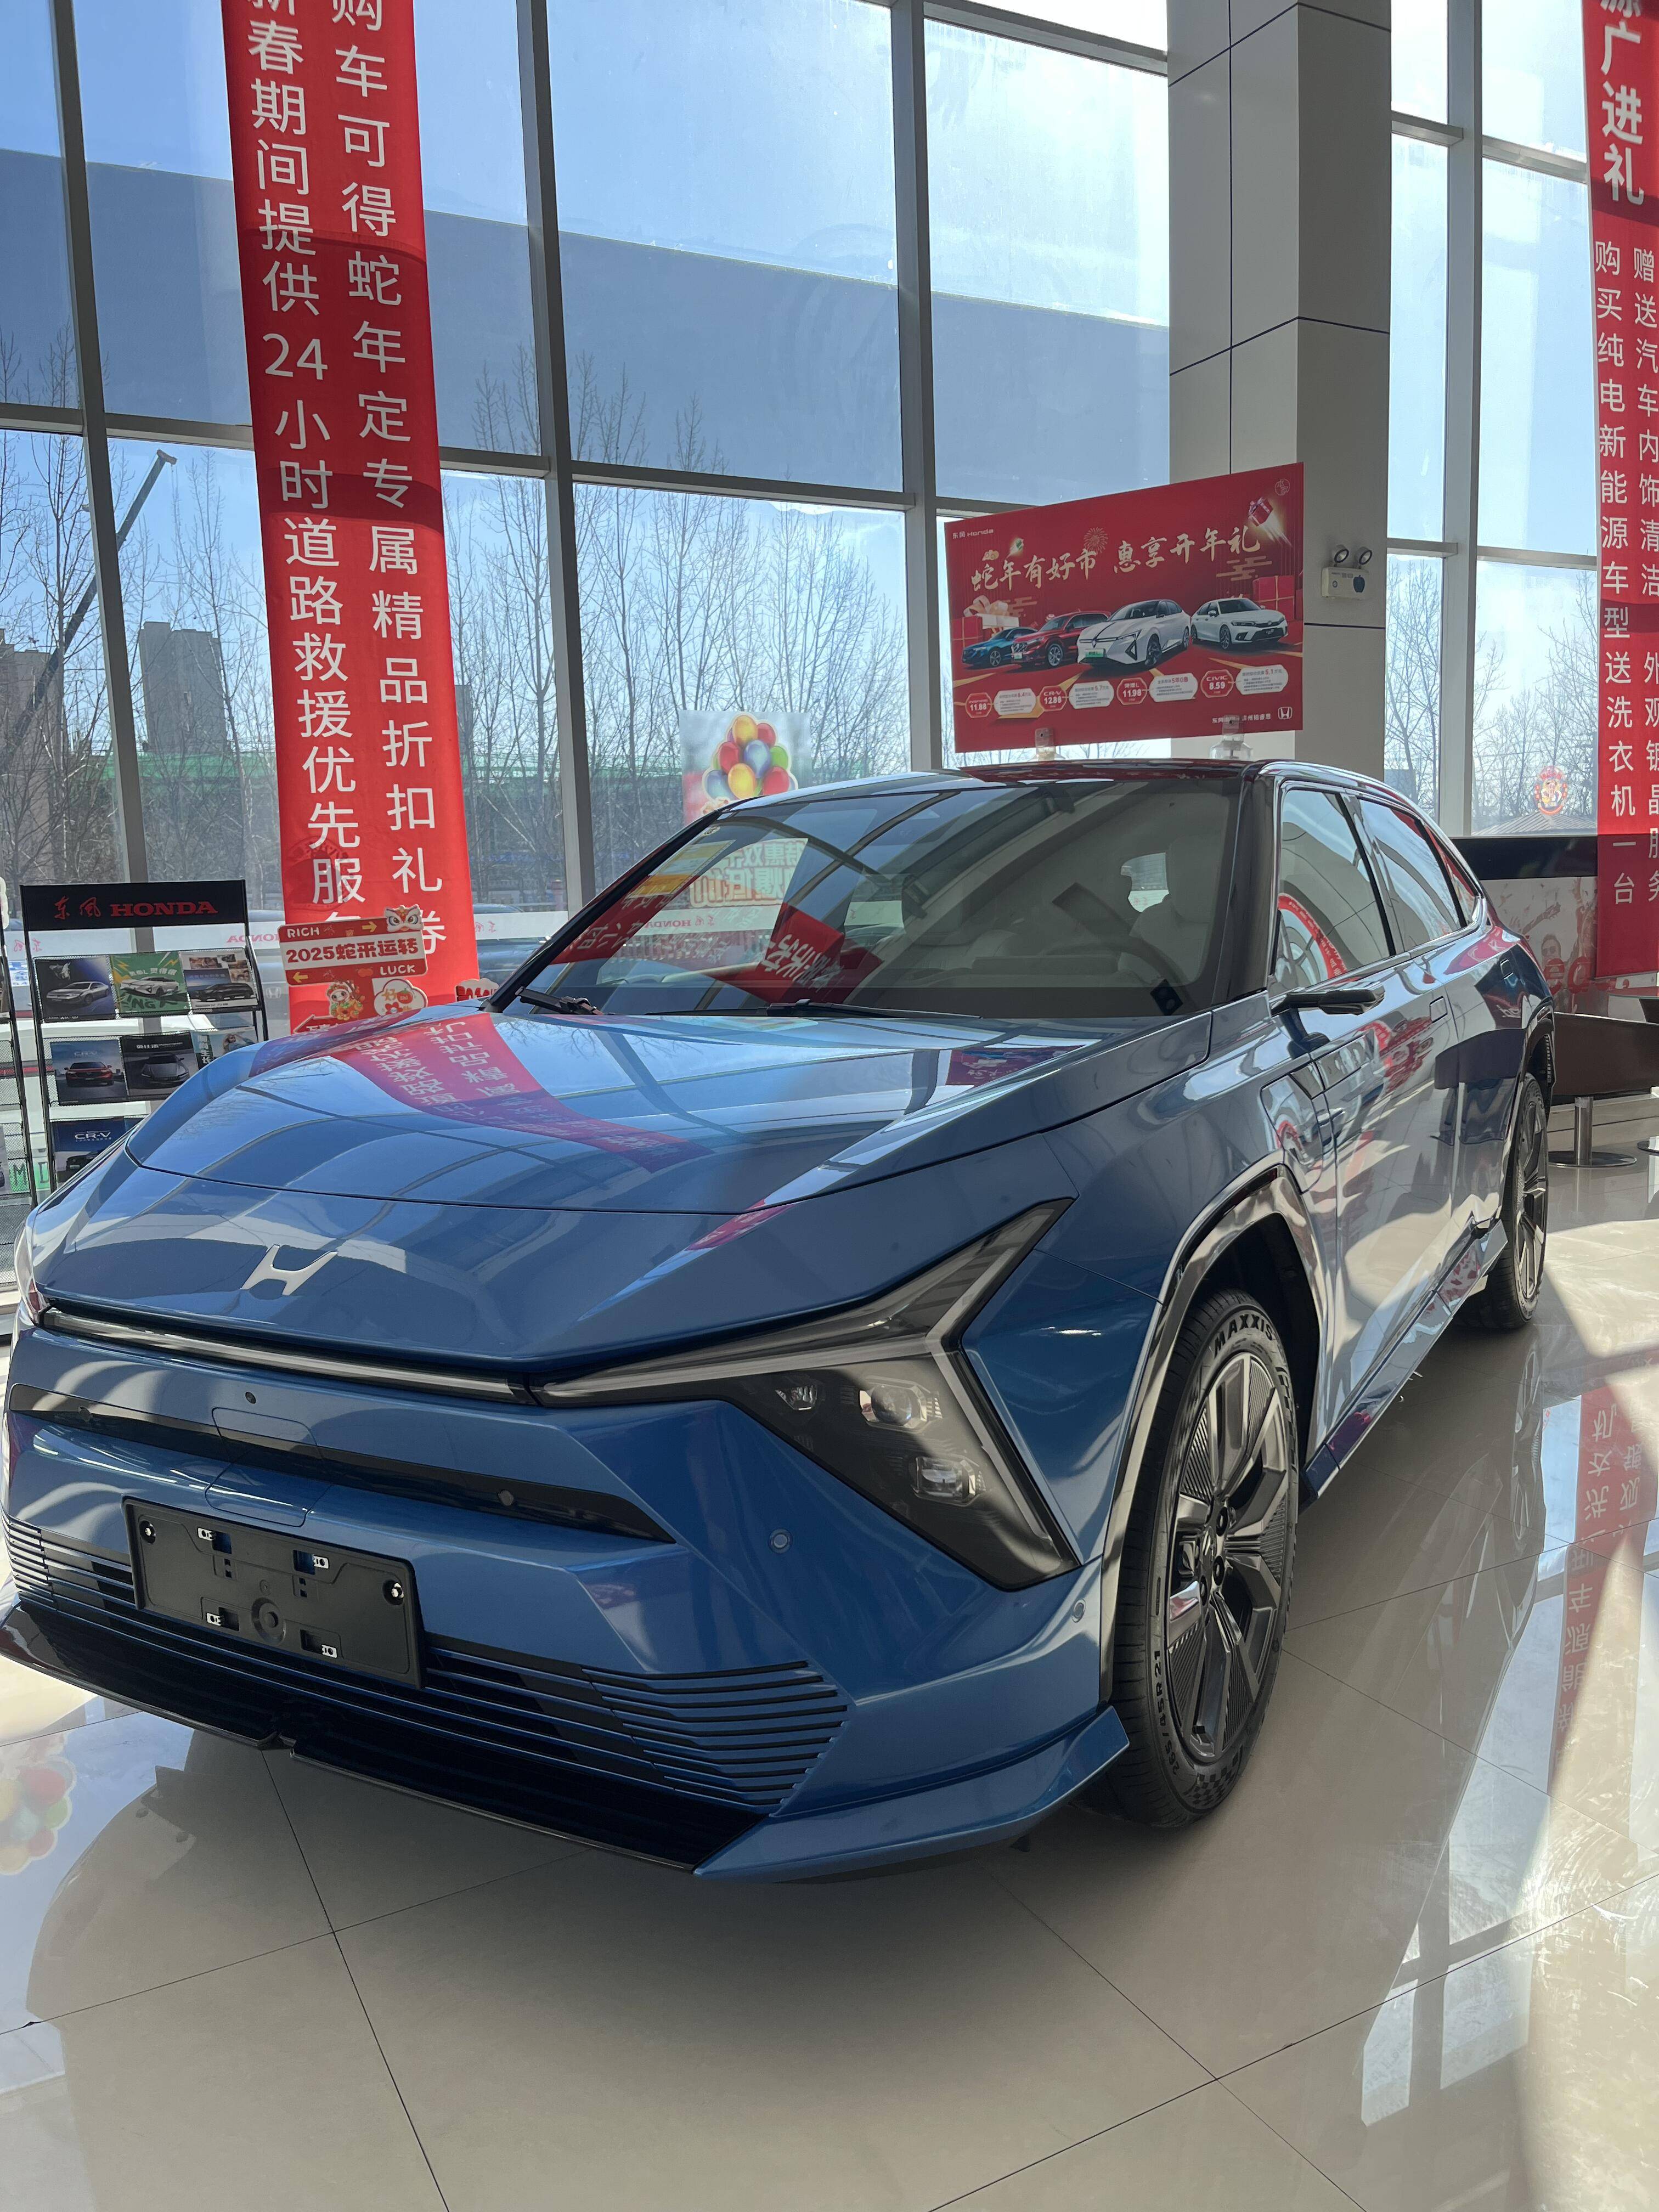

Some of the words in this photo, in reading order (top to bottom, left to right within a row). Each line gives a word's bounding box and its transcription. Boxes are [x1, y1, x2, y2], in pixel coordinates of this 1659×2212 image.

[967, 528, 994, 537] Honda
[971, 549, 1097, 591] 蛇年有好市
[1114, 525, 1260, 573] 惠享开年礼
[1209, 682, 1226, 690] 8.59
[111, 901, 218, 917] HONDA
[287, 927, 320, 939] RICH
[286, 938, 419, 963] 2025蛇来运转
[380, 964, 416, 975] LUCK
[75, 1131, 111, 1139] CR-V
[1214, 1314, 1273, 1359] MAXXIS
